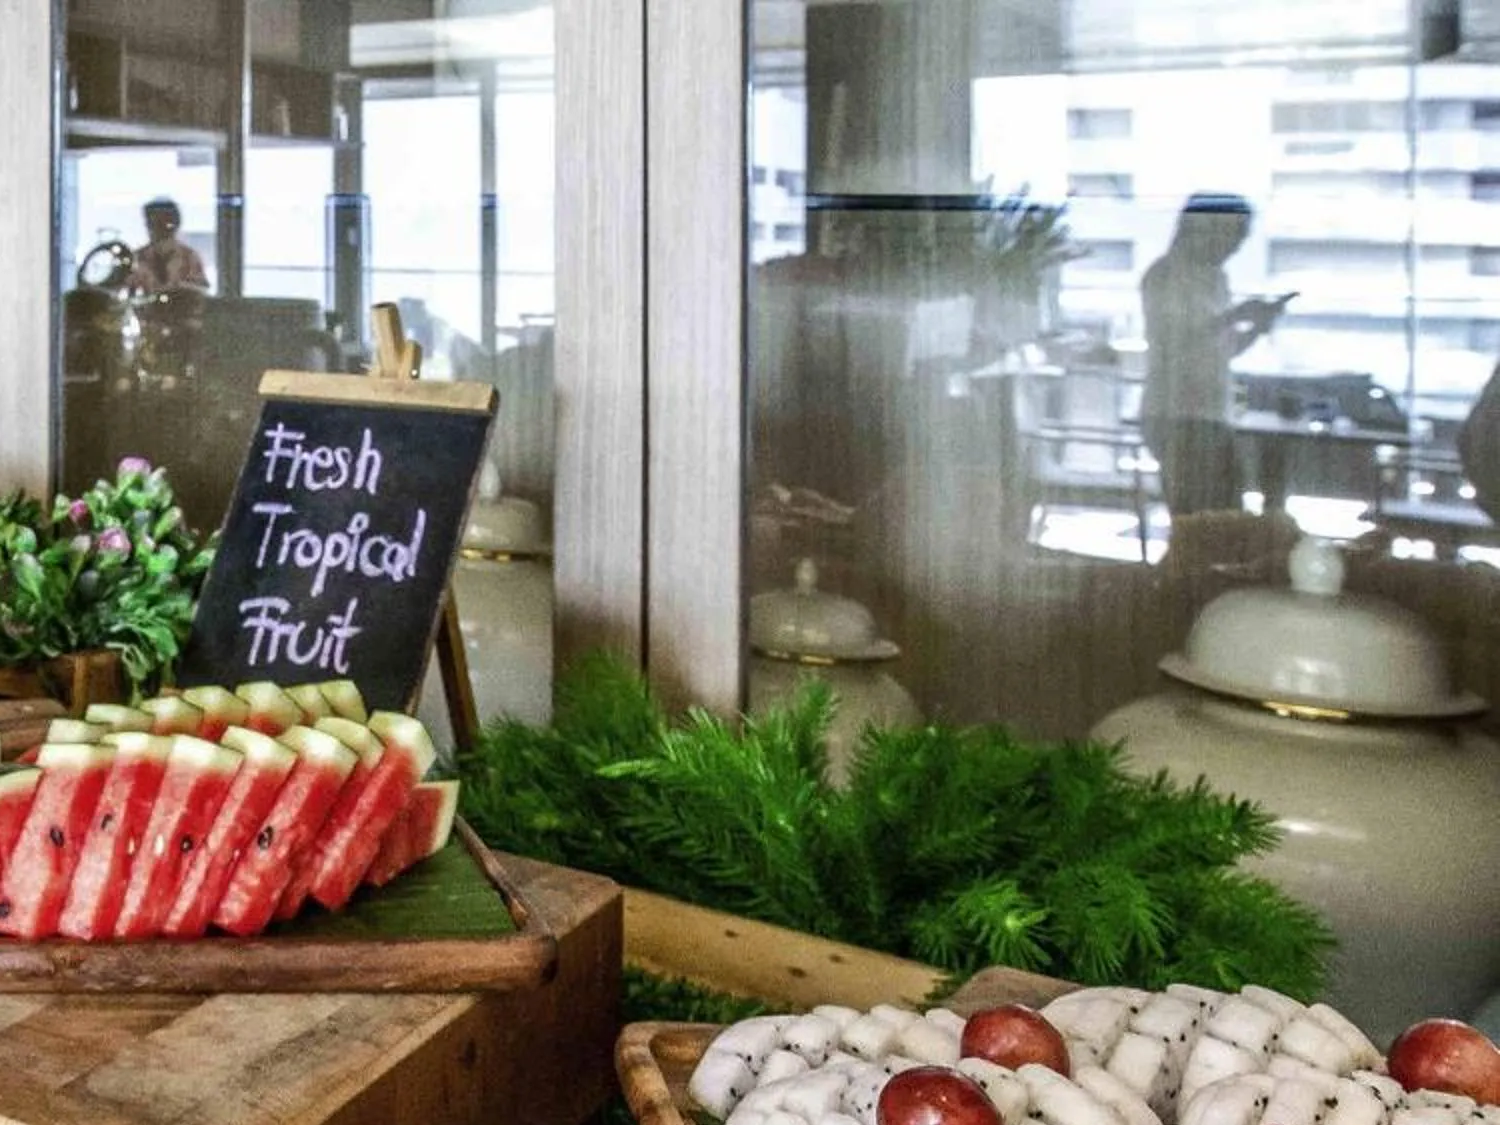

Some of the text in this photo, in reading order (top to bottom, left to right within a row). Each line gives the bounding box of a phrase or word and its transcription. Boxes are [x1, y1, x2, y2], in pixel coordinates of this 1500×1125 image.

[264, 422, 382, 494] Fresh
[252, 503, 426, 597] Tropical
[239, 597, 362, 674] Fruit
